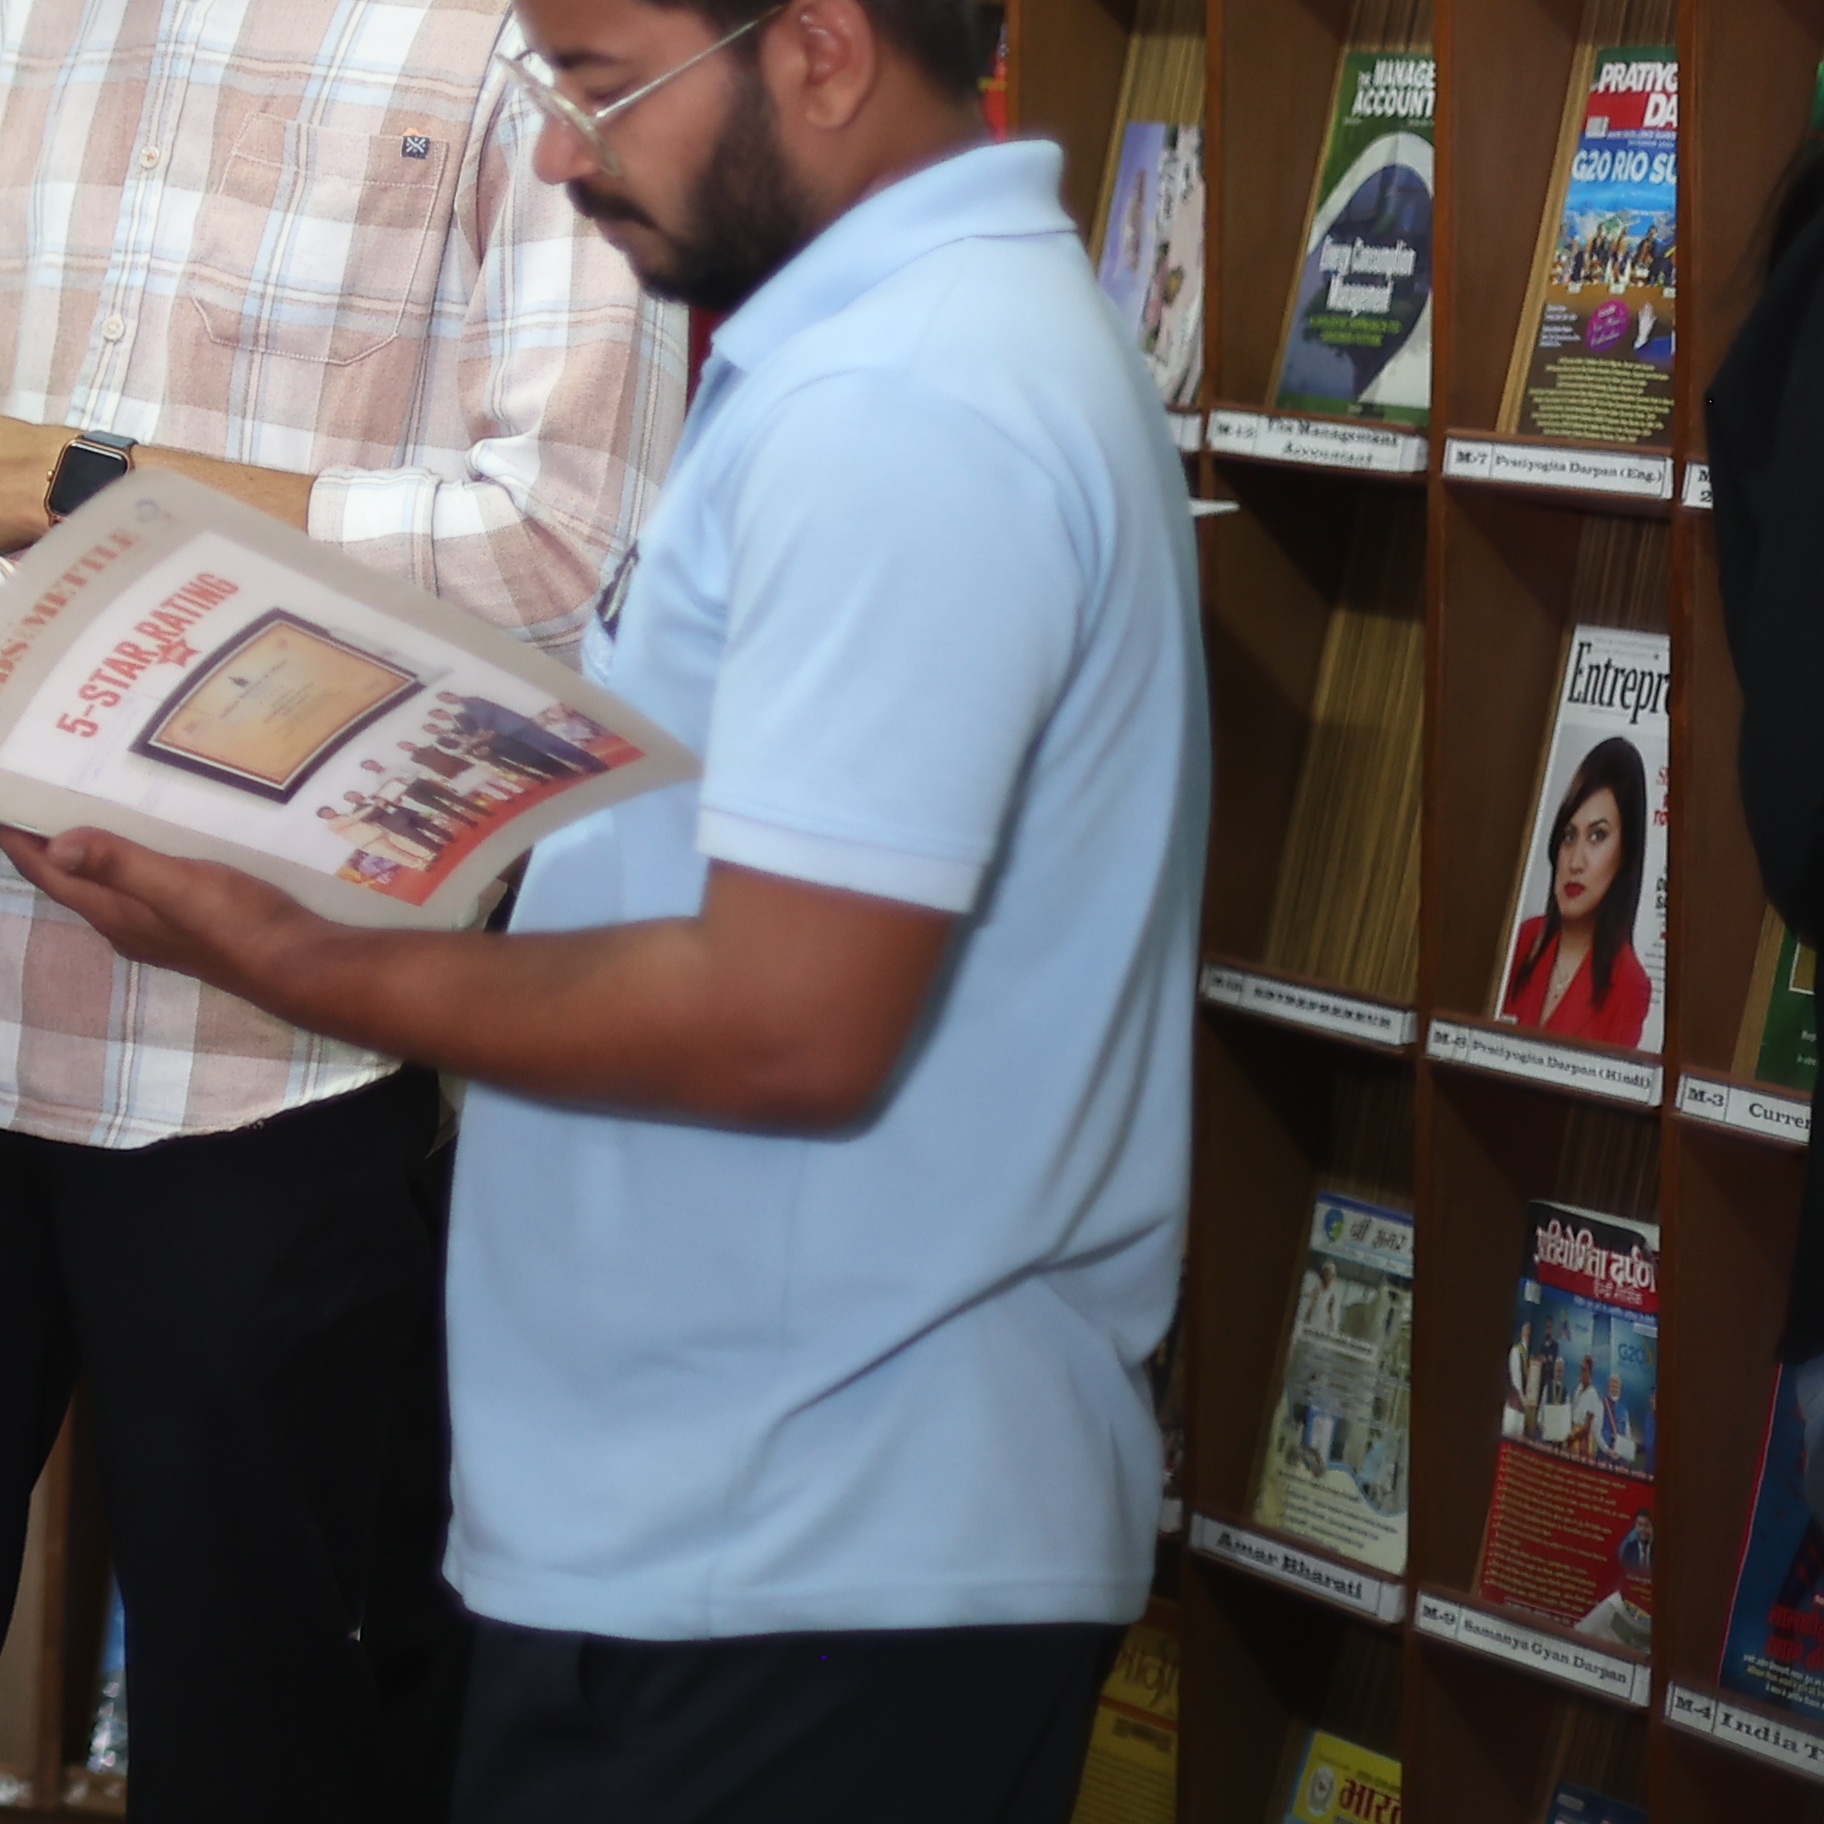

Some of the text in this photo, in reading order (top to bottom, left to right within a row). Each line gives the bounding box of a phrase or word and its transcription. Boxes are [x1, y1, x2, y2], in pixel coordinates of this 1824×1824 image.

[56, 572, 241, 739] 5-STAR RATING
[1687, 1087, 1725, 1108] M-3
[1281, 1554, 1363, 1601] Bharati
[1463, 1618, 1530, 1651] Samanya
[1530, 1643, 1571, 1664] Gyan
[1572, 1654, 1628, 1685] Darpan
[1674, 1695, 1713, 1721] M-4
[1720, 1710, 1800, 1755] India
